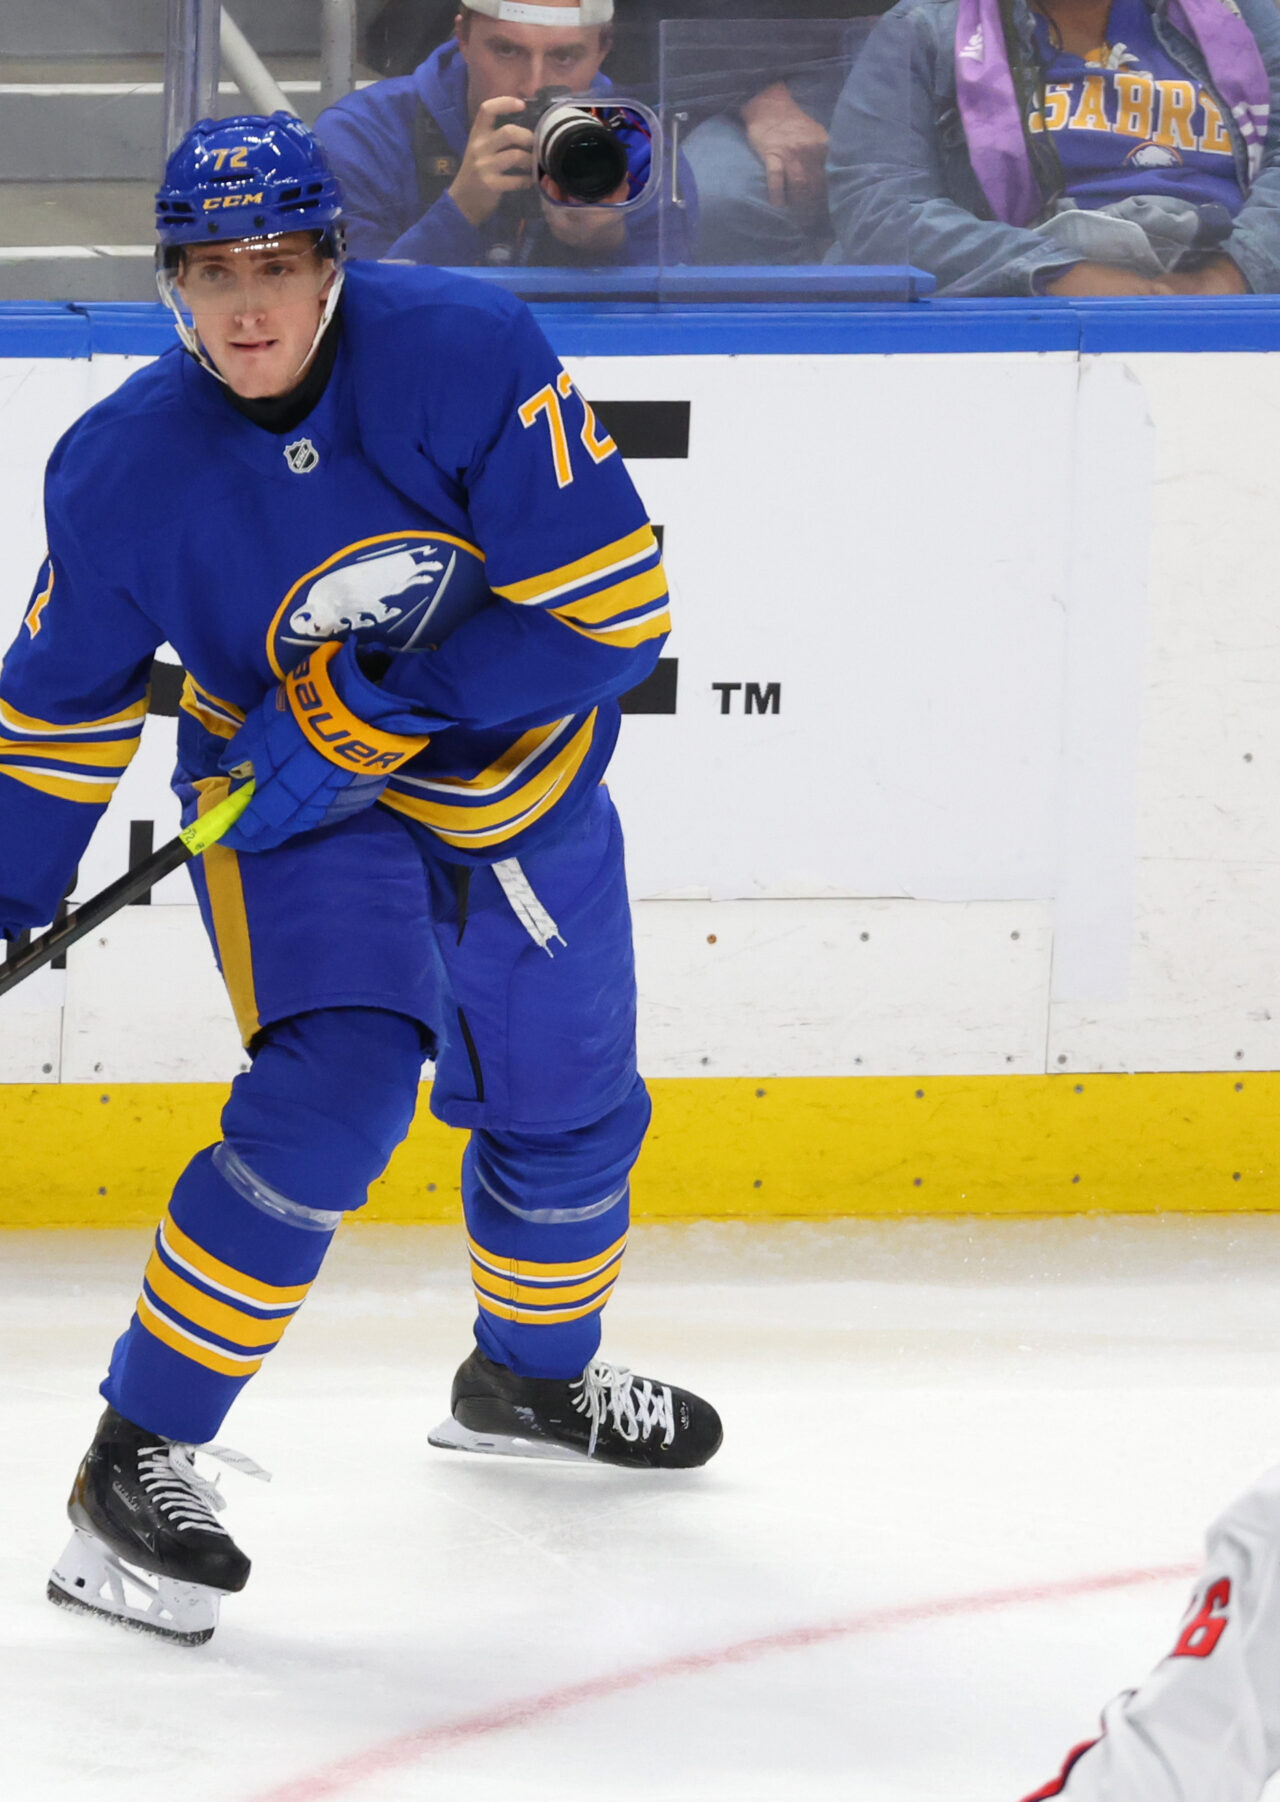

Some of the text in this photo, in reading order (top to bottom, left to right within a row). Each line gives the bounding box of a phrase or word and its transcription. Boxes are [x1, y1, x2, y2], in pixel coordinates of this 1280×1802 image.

[211, 146, 249, 171] 72
[202, 192, 265, 211] CCM
[517, 369, 618, 490] 72
[712, 681, 782, 715] TM
